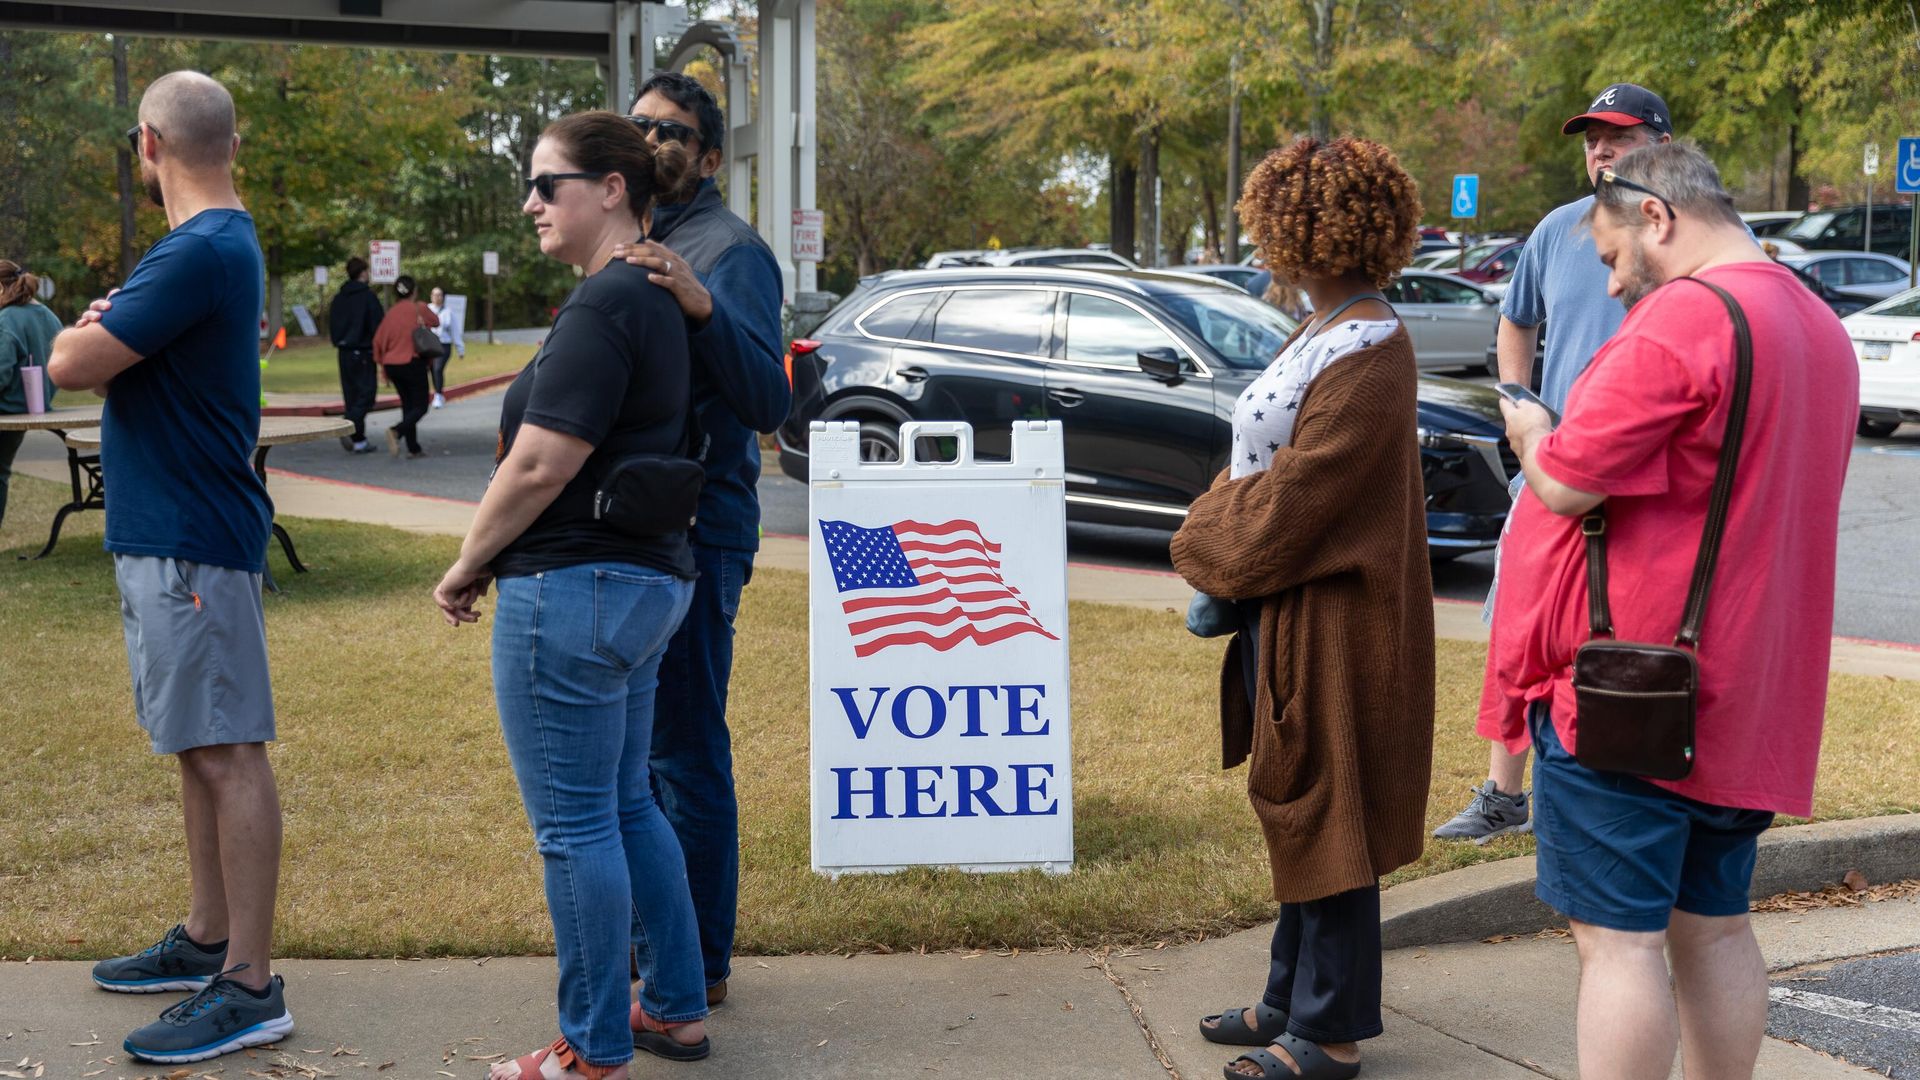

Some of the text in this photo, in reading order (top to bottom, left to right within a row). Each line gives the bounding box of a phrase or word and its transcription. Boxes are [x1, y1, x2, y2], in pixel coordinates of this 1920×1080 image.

[1592, 88, 1618, 108] A
[796, 229, 817, 241] FIRE
[794, 243, 818, 254] LANE
[375, 256, 393, 265] FIRE
[373, 268, 395, 277] LANE
[831, 685, 1050, 739] VOTE
[830, 764, 1058, 819] HERE
